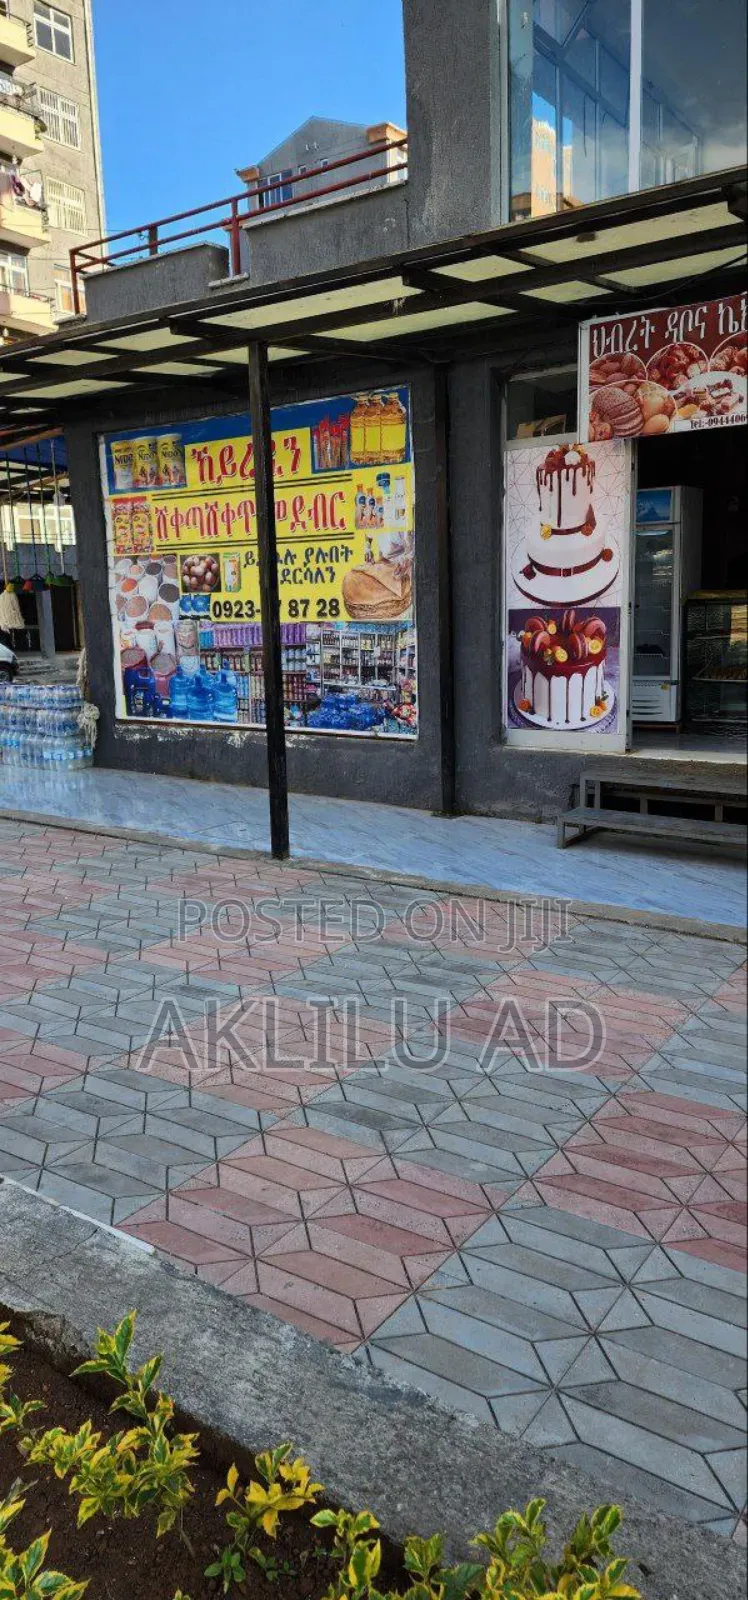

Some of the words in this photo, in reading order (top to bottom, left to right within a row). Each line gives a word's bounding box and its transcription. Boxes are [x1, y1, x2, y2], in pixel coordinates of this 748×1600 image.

[664, 305, 708, 344] ዳቦና
[288, 598, 310, 618] 87
[316, 597, 341, 618] 28
